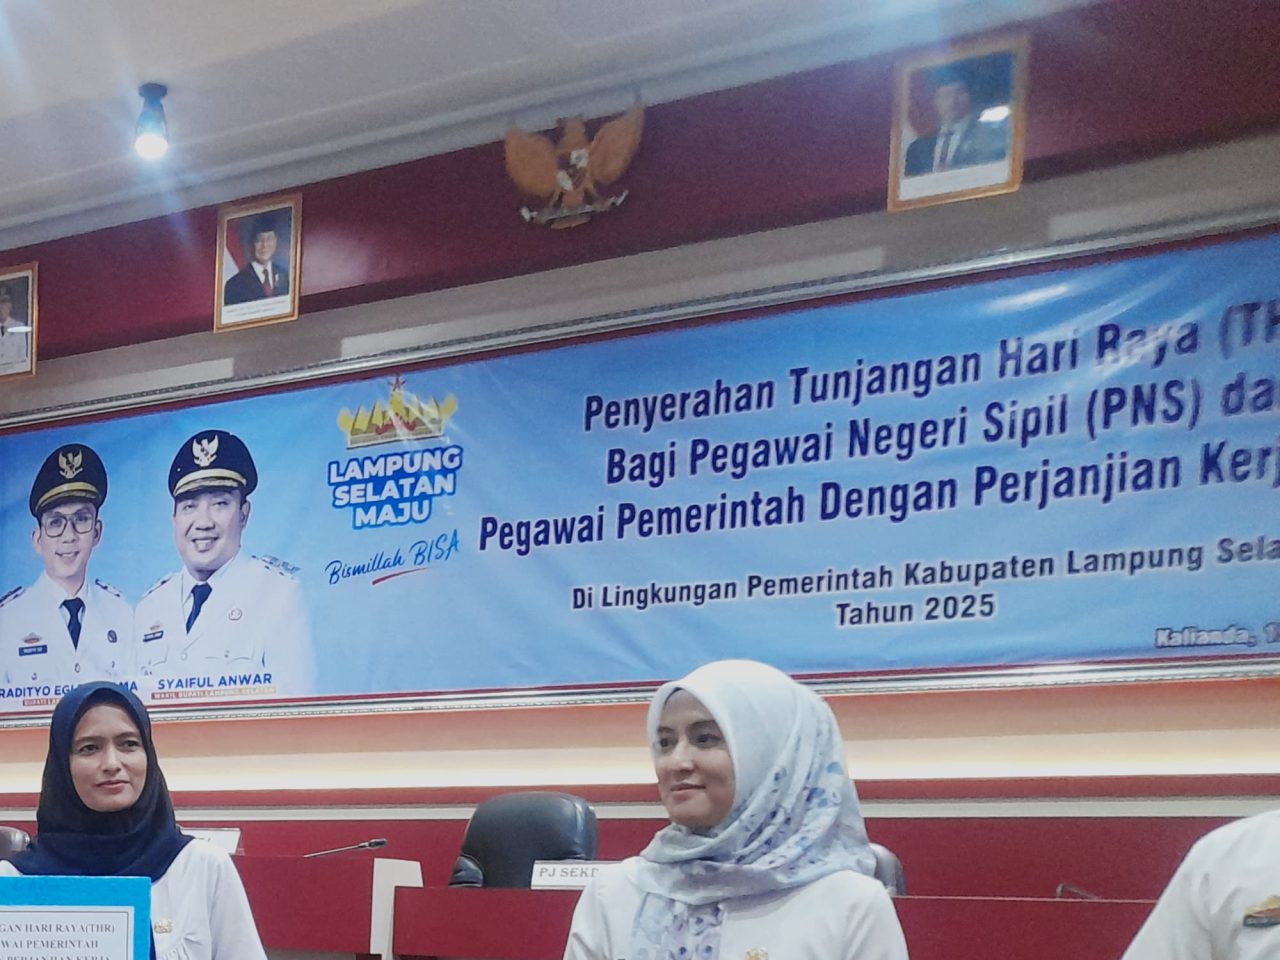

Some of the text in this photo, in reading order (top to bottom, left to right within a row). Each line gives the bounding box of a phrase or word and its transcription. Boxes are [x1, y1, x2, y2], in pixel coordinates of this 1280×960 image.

[584, 379, 775, 433] Penyerahan
[789, 353, 981, 406] Tunjangan
[999, 333, 1079, 378] Hari
[1096, 320, 1200, 369] Raya
[606, 440, 677, 488] Bagi
[689, 421, 833, 480] Pegawai
[848, 405, 968, 461] Negeri
[983, 393, 1069, 448] Sipil
[1086, 377, 1201, 441] (PNS)
[329, 446, 462, 484] LAMPUNG
[334, 472, 455, 506] SELATAN
[479, 506, 605, 556] Pegawai
[616, 485, 805, 540] Pemerintah
[819, 477, 958, 523] Dengan
[974, 452, 1181, 510] Perjanjian
[354, 499, 430, 528] MAJU
[325, 528, 460, 585] Bismillah BISA
[572, 587, 593, 609] Di
[601, 580, 737, 610] Lingkungan
[747, 565, 893, 598] Pemerintah
[904, 555, 1054, 586] Kabupaten
[1067, 545, 1203, 576] Lampung
[836, 593, 996, 626] Tahun 2025
[157, 673, 273, 690] SYAIFUL ANWAR
[539, 867, 556, 878] PJ
[25, 923, 53, 933] HARI
[26, 940, 99, 949] PEMERINTAH
